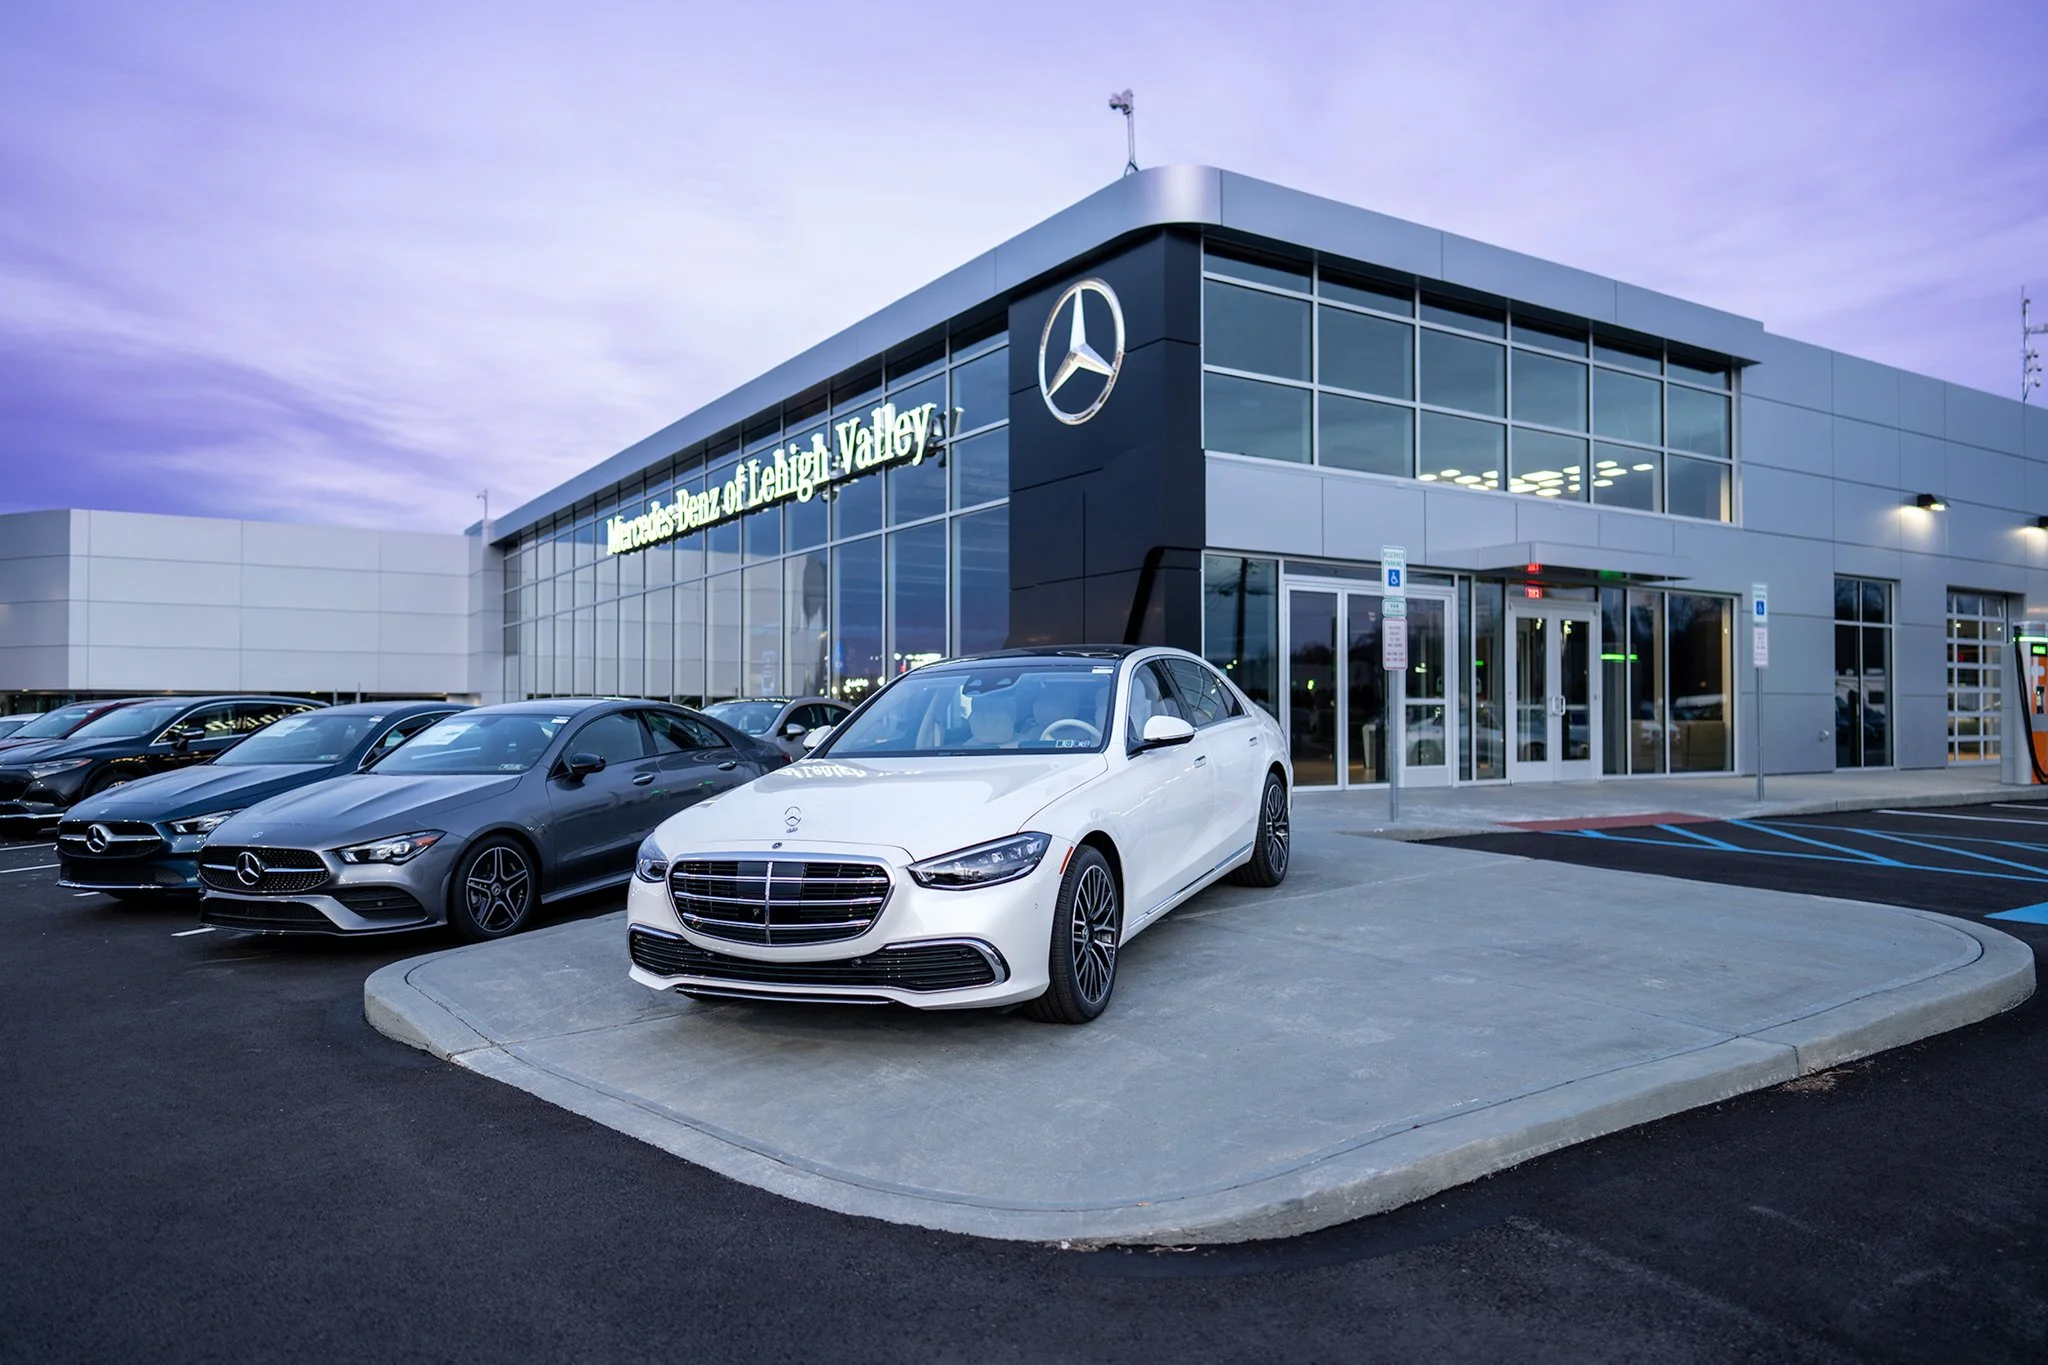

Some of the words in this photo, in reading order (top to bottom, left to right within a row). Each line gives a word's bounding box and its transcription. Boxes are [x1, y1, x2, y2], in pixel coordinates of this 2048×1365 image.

[606, 486, 720, 556] Mercedes-Benz
[723, 463, 745, 515] of
[747, 433, 830, 503] Lehigh
[835, 402, 938, 474] Valley
